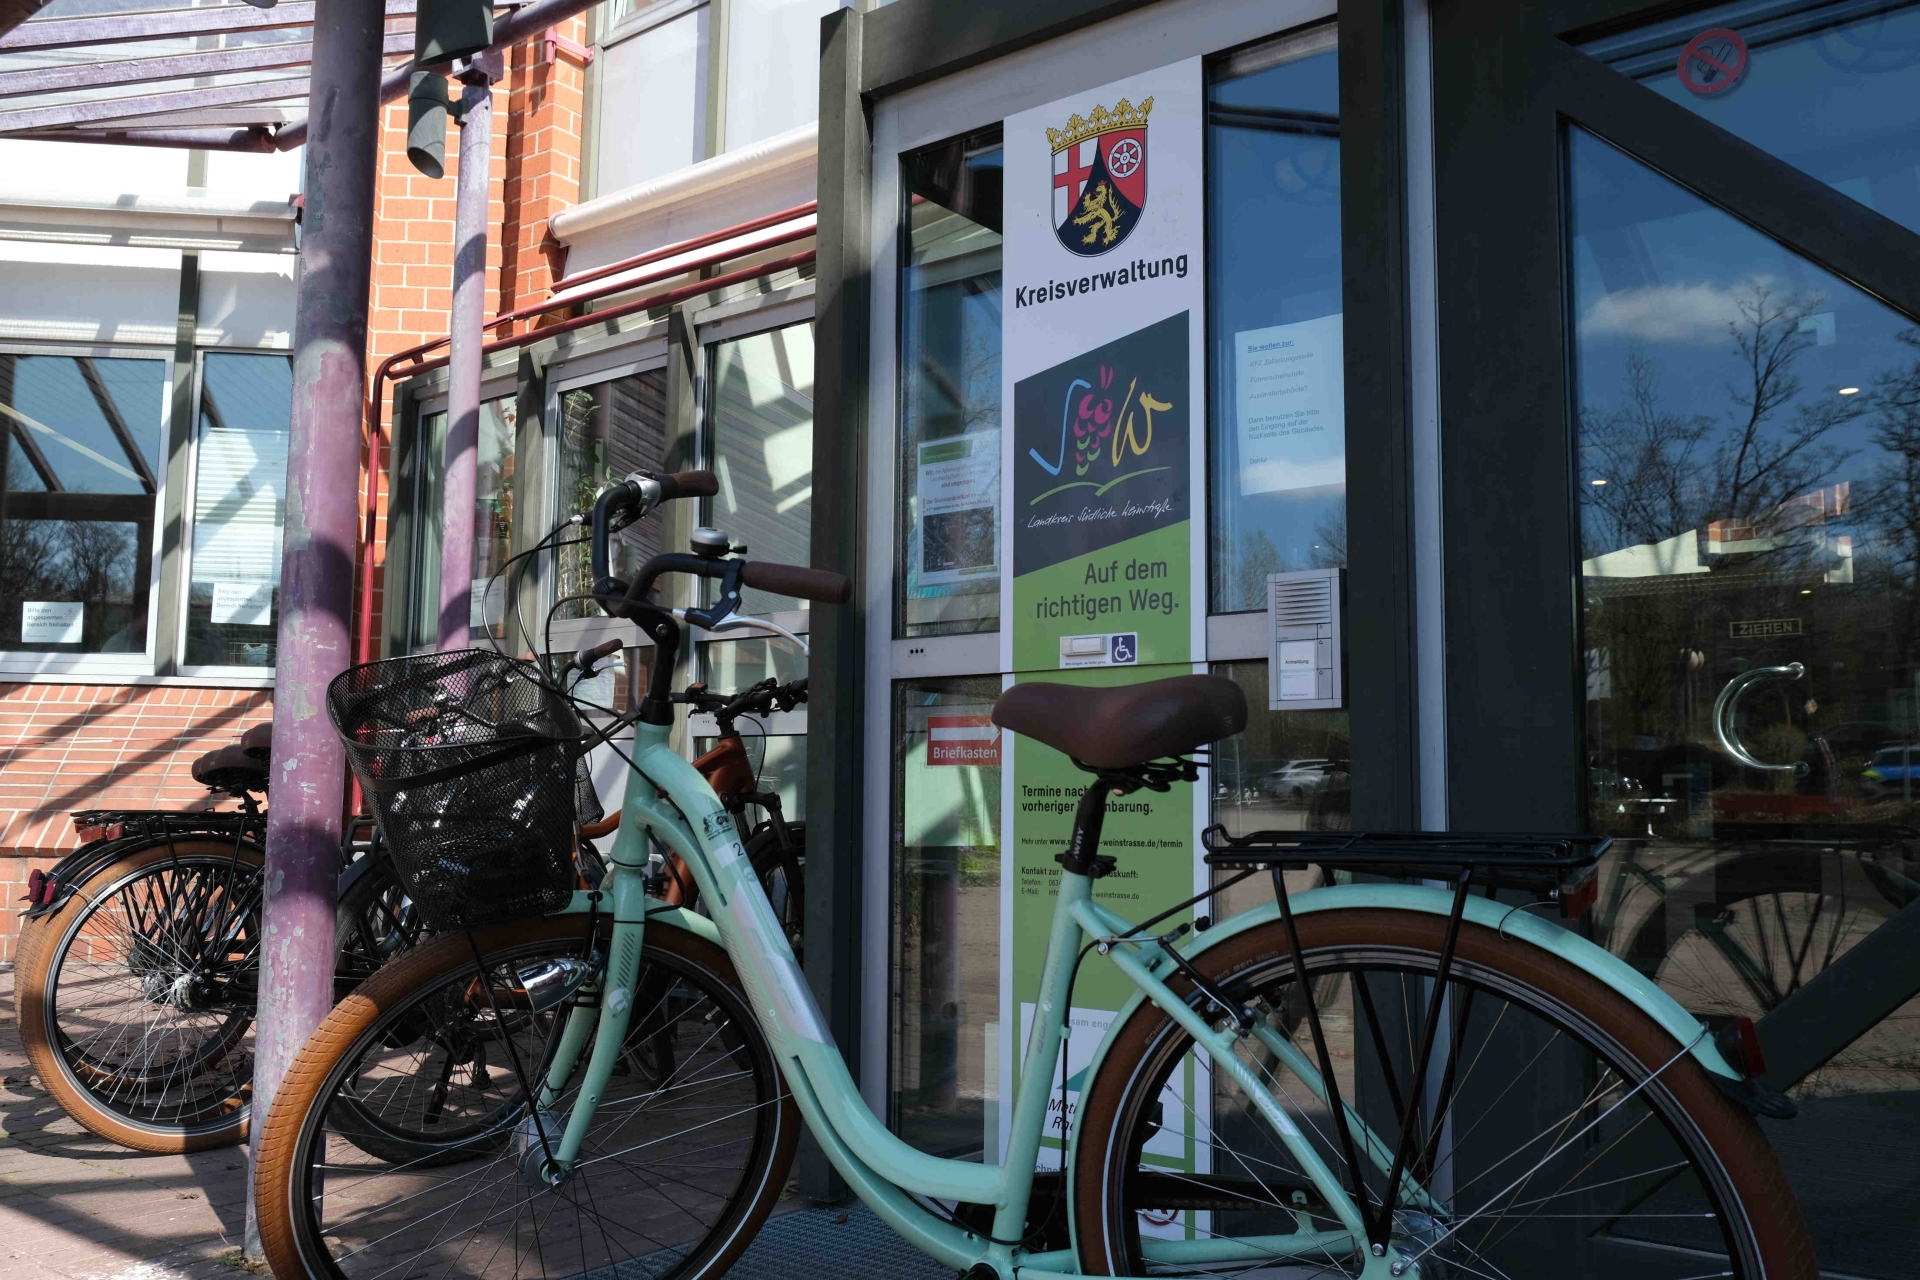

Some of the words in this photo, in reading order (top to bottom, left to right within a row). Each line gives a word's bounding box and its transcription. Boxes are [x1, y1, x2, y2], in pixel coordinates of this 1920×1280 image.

[1015, 254, 1188, 309] Kreisverwaltung
[1247, 345, 1258, 353] Sie
[1259, 341, 1281, 351] wollen
[1248, 416, 1264, 425] Dann
[1265, 413, 1294, 422] benutzen
[1295, 410, 1306, 418] Sie
[1306, 408, 1320, 416] bitte
[1248, 424, 1260, 432] den
[1260, 421, 1286, 432] Eingang
[1278, 428, 1291, 436] des
[1027, 511, 1073, 529] Landkreis
[1078, 505, 1118, 523] Südliche
[1121, 498, 1174, 523] Weinstraße
[1084, 560, 1119, 585] Auf
[1125, 558, 1168, 581] dem
[1036, 593, 1122, 621] richtigen
[1128, 588, 1180, 616] Weg.
[1739, 621, 1793, 636] ZIEHEN
[933, 745, 997, 759] Briefkasten
[1022, 785, 1062, 797] Termine
[1022, 800, 1074, 815] vorheriger
[1021, 837, 1034, 845] Mehr
[732, 842, 745, 857] 2
[1021, 866, 1047, 876] Kontakt
[1048, 868, 1060, 876] zur
[1105, 870, 1139, 879] skunft:
[1021, 878, 1043, 886] Telefon:
[1021, 887, 1040, 895] E-Mail:
[1070, 1017, 1089, 1028] sam
[1091, 1020, 1112, 1031] eng
[1145, 1014, 1172, 1045] SCHWA
